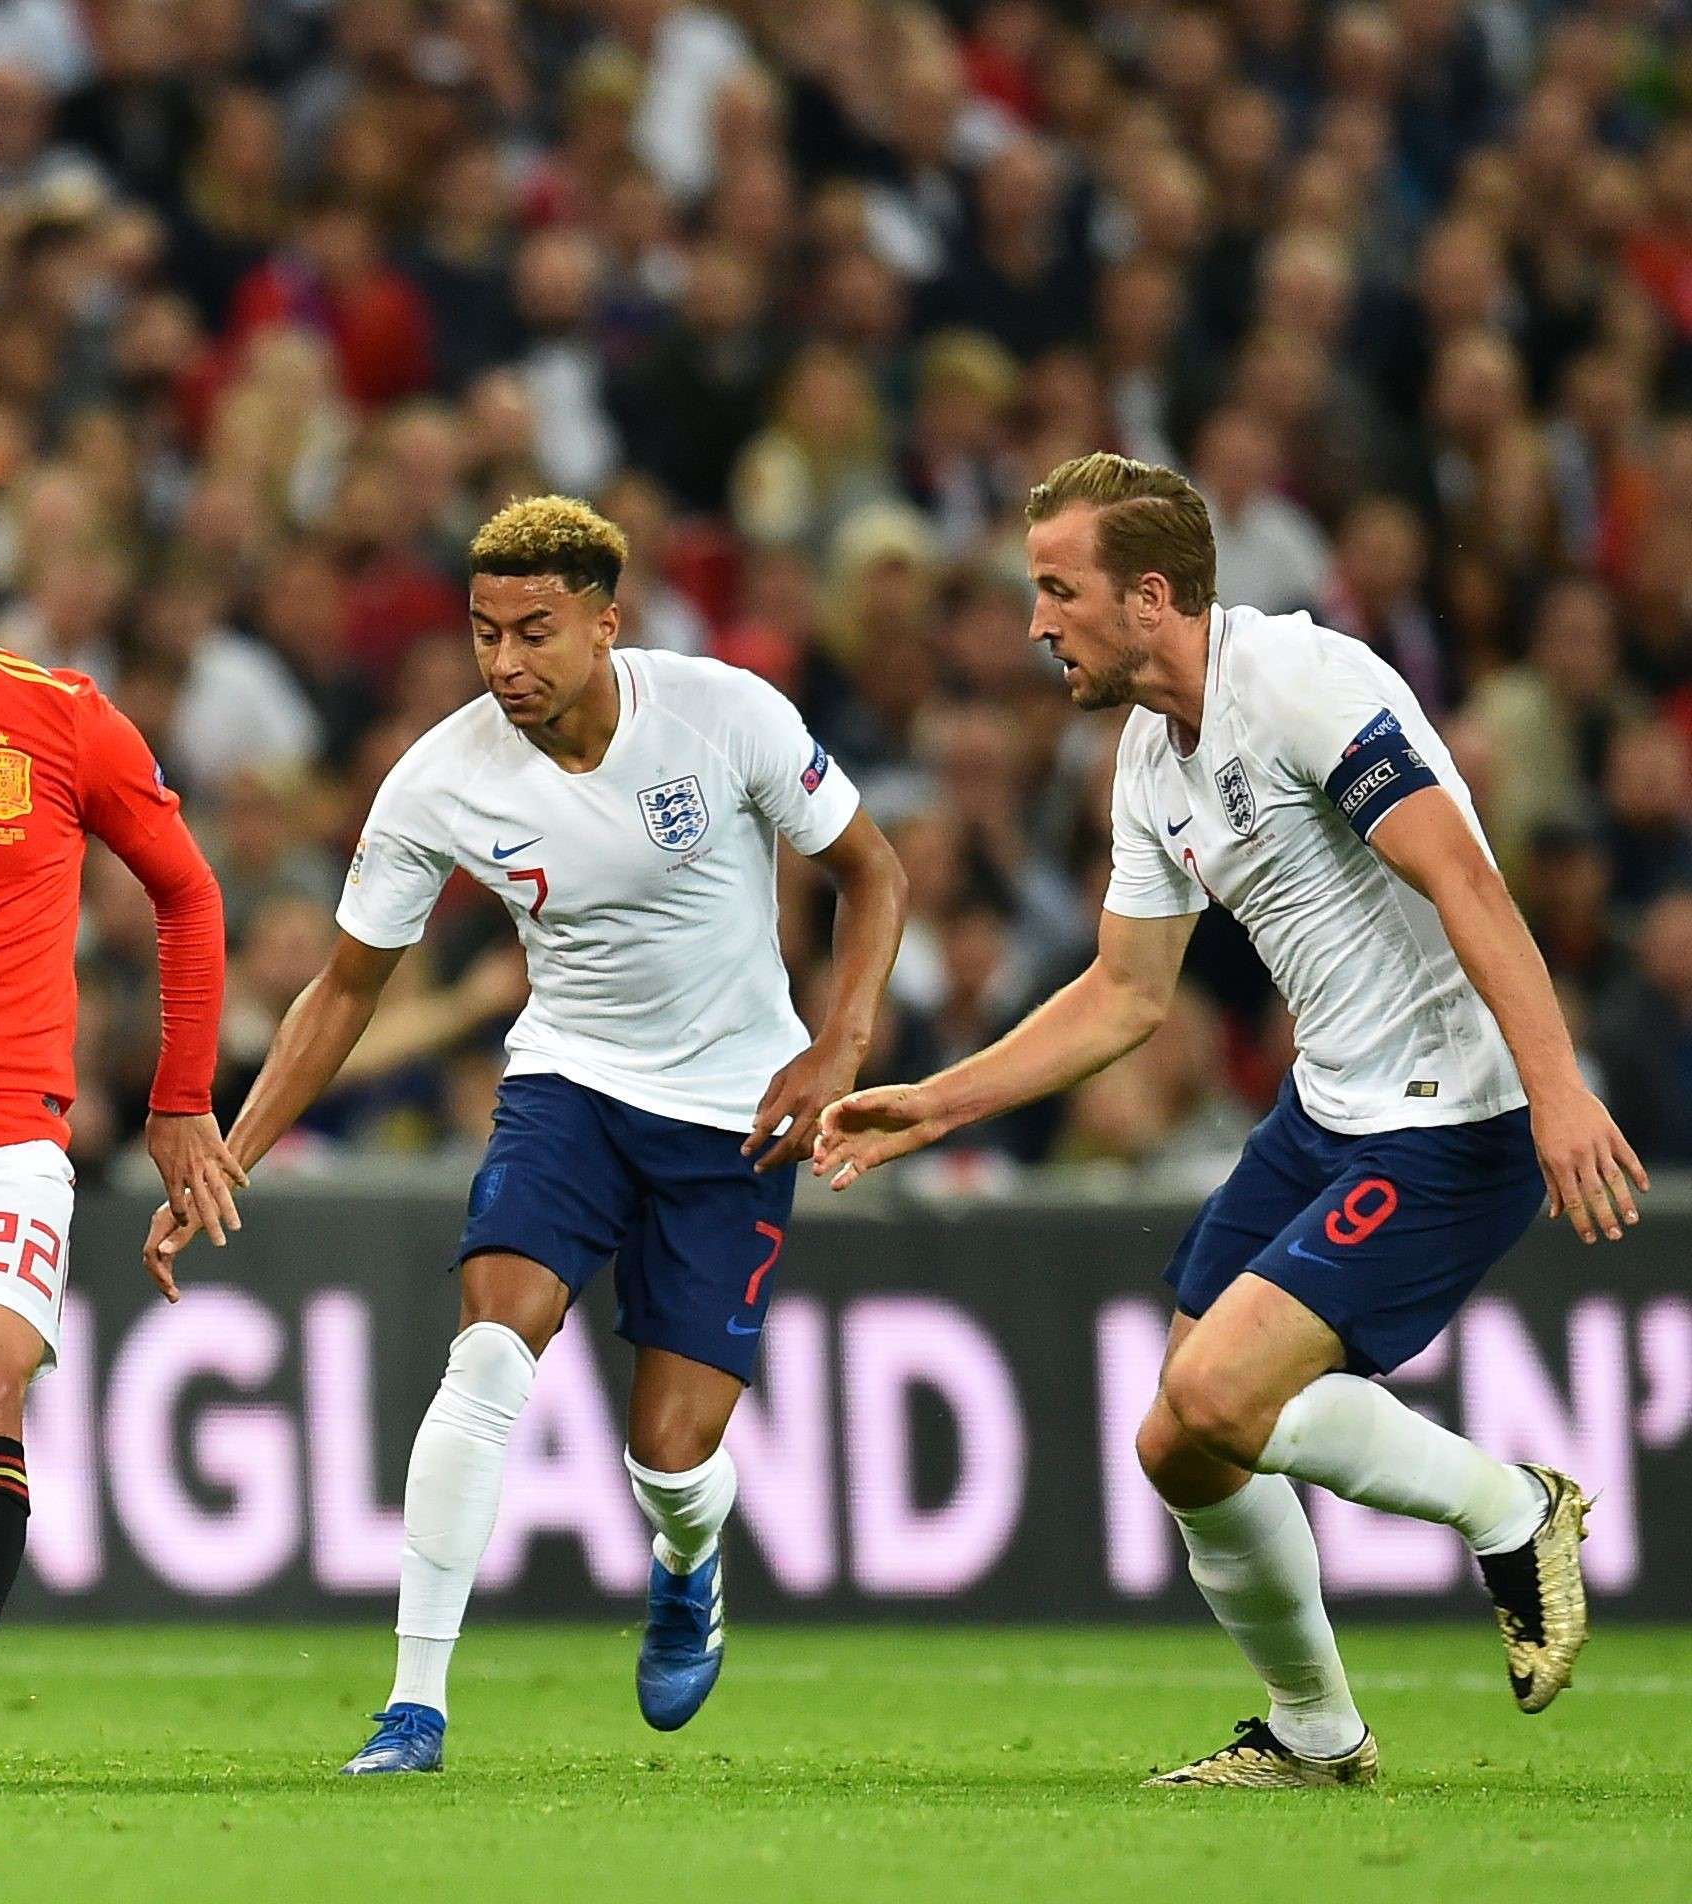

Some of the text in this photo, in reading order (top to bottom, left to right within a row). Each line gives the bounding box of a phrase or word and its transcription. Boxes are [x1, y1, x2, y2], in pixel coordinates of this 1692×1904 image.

[1342, 761, 1395, 813] RESPECT
[506, 868, 548, 926] 7
[1326, 1179, 1397, 1244] 9
[745, 1221, 783, 1305] 7
